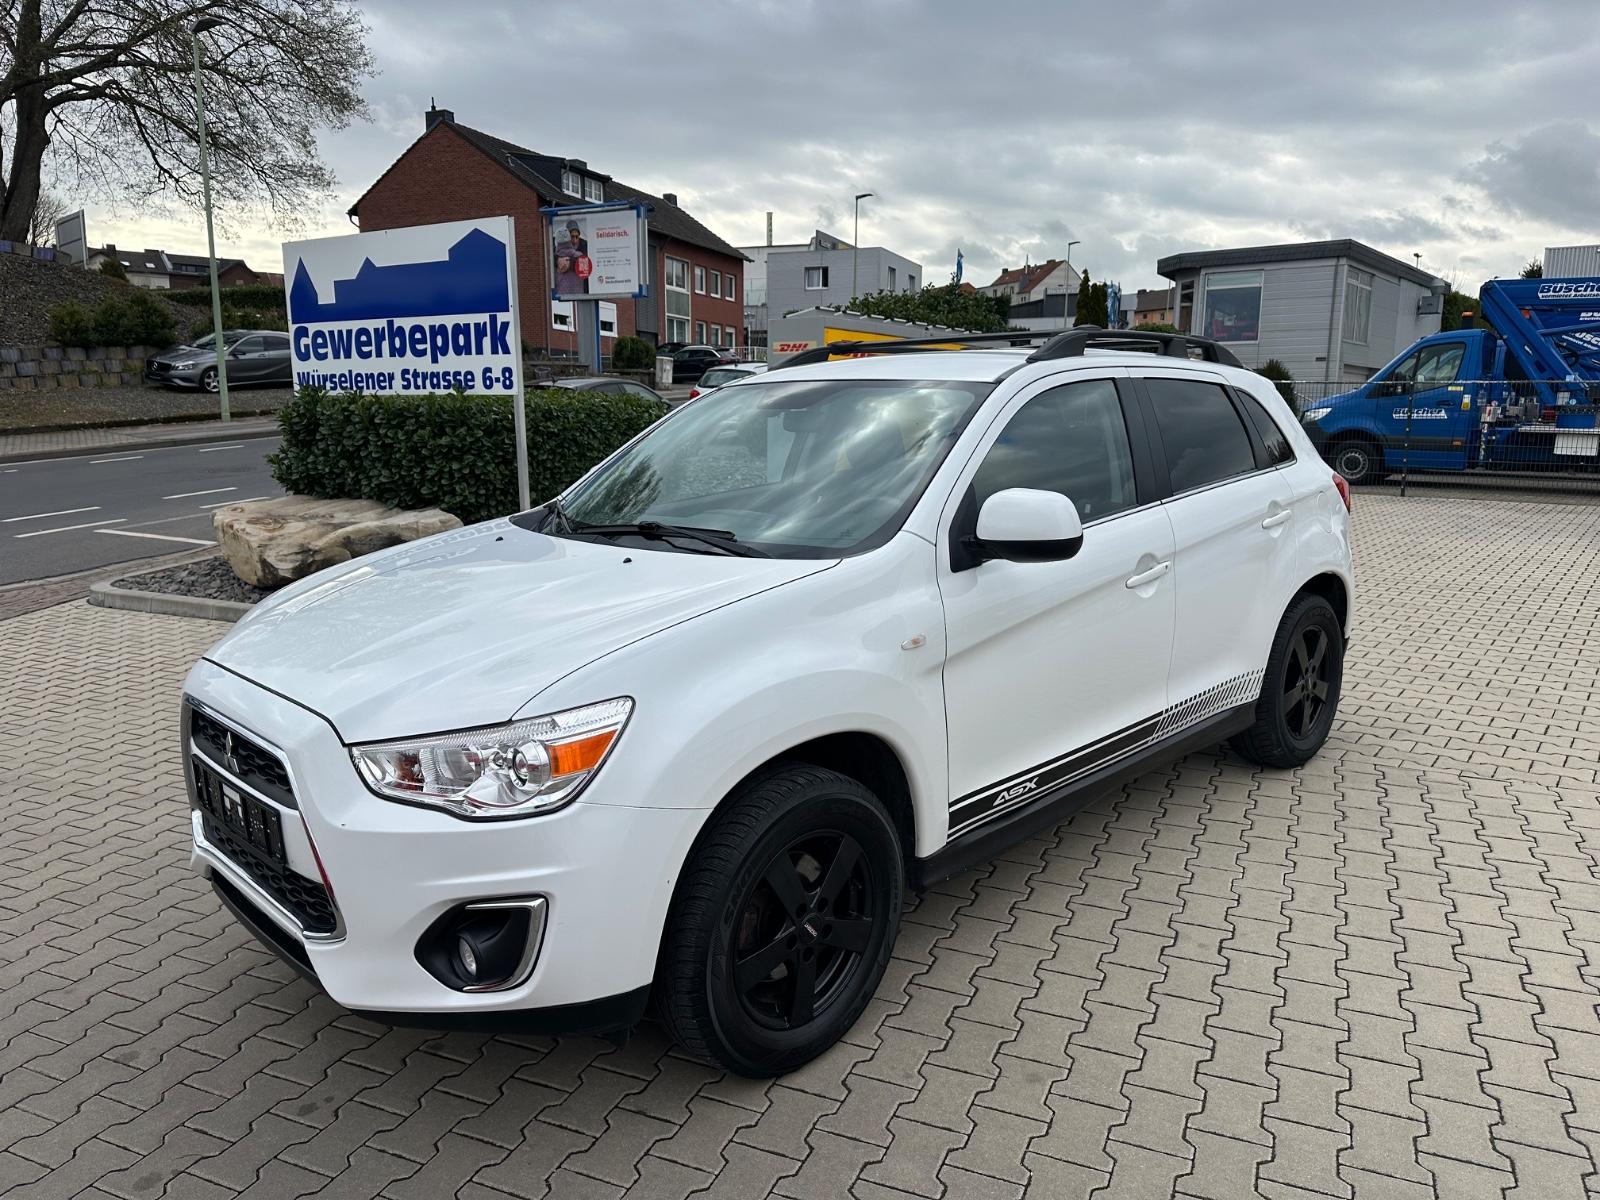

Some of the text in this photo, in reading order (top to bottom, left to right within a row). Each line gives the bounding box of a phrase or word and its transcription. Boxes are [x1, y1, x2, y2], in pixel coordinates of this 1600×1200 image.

[293, 314, 511, 364] Gewerbepark
[778, 343, 809, 352] DHL
[297, 366, 514, 391] Würselener Strasse 6-8
[992, 777, 1039, 806] ASX
